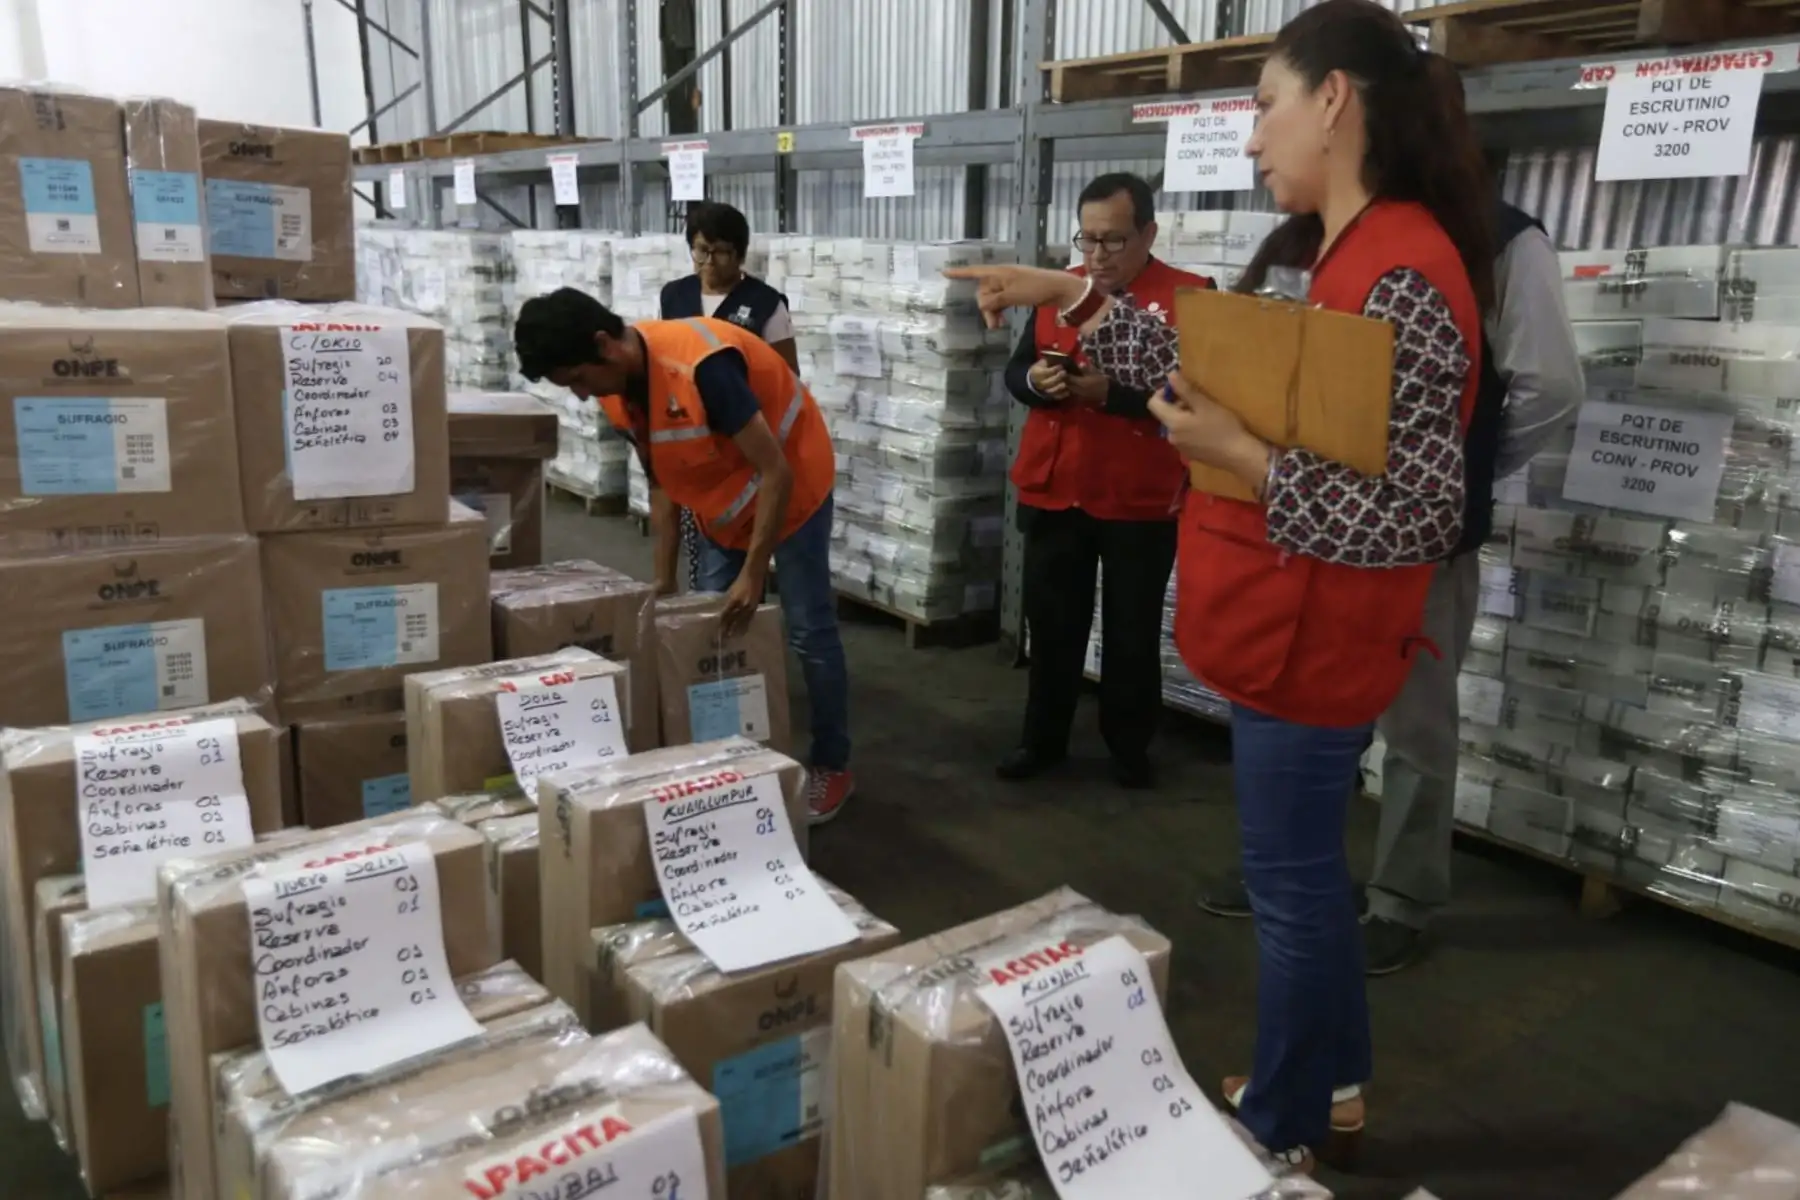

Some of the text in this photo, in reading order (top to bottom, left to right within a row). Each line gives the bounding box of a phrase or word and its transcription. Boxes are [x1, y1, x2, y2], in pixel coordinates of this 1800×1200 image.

[1651, 77, 1712, 93] PQT DE
[1629, 95, 1730, 115] ESCRUTINIO
[1180, 131, 1238, 144] ESCRUTINIO
[1622, 122, 1669, 137] CONV
[1683, 118, 1730, 134] PROV
[1177, 149, 1205, 159] CONV
[1212, 148, 1240, 158] PROV
[1654, 142, 1690, 157] 3200
[53, 359, 118, 377] ONPE
[57, 414, 128, 424] SUFRAGIO
[1621, 413, 1683, 433] PQT DE
[1600, 430, 1700, 456] ESCRUTINIO
[1591, 450, 1637, 468] CONV
[1650, 459, 1699, 478] PROV
[1621, 476, 1656, 493] 3200
[103, 637, 168, 653] SUFRAGIO
[83, 761, 161, 782] Reserva
[83, 779, 186, 798] Coordinador
[253, 896, 347, 927] Sufragio
[254, 923, 341, 949] Reserva
[256, 935, 369, 976] Coordinador
[264, 992, 350, 1023] Cabinas
[1018, 1023, 1086, 1065] Reserva
[1025, 1035, 1115, 1094] Coordinador
